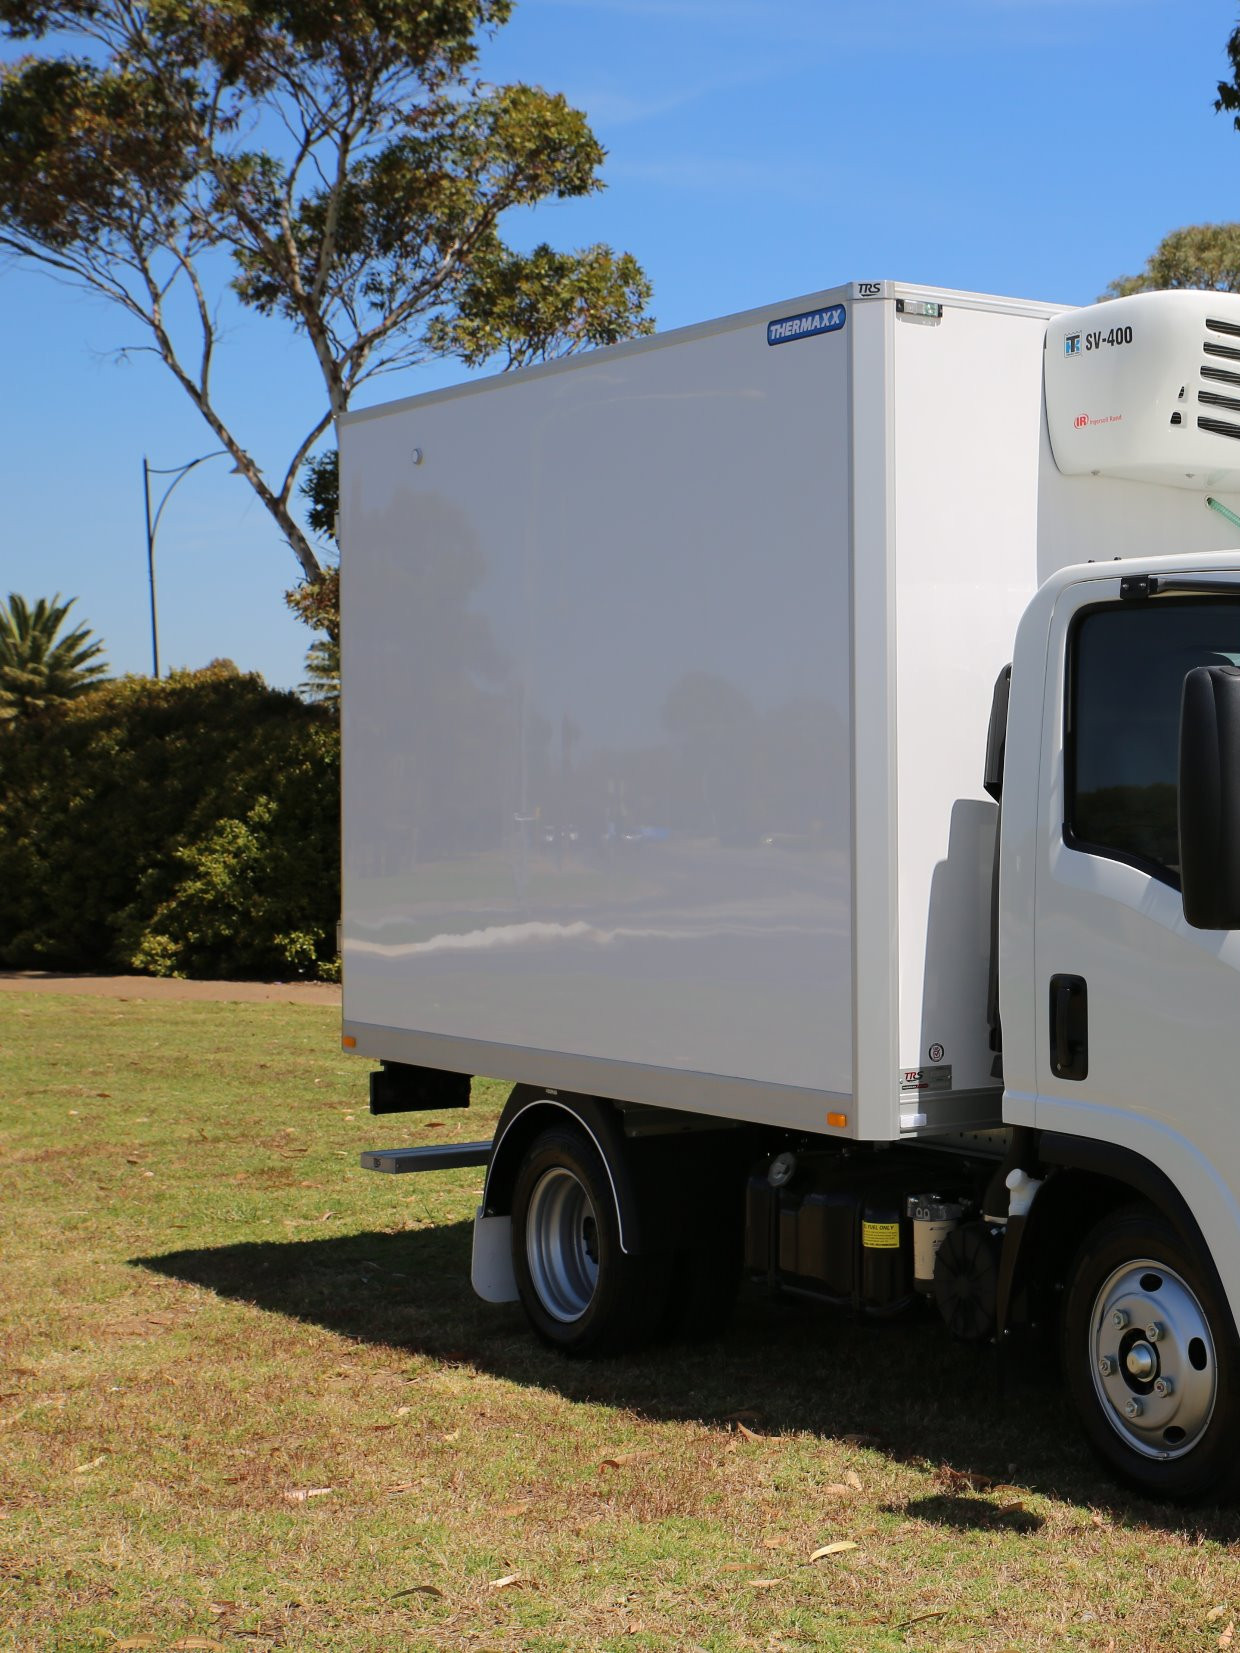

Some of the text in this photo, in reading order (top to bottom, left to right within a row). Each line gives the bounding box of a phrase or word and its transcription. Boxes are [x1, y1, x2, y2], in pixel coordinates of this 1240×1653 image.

[858, 282, 881, 294] TRS
[770, 308, 842, 340] THERMAXX
[1085, 326, 1133, 351] SV-400
[904, 1071, 924, 1081] TRS
